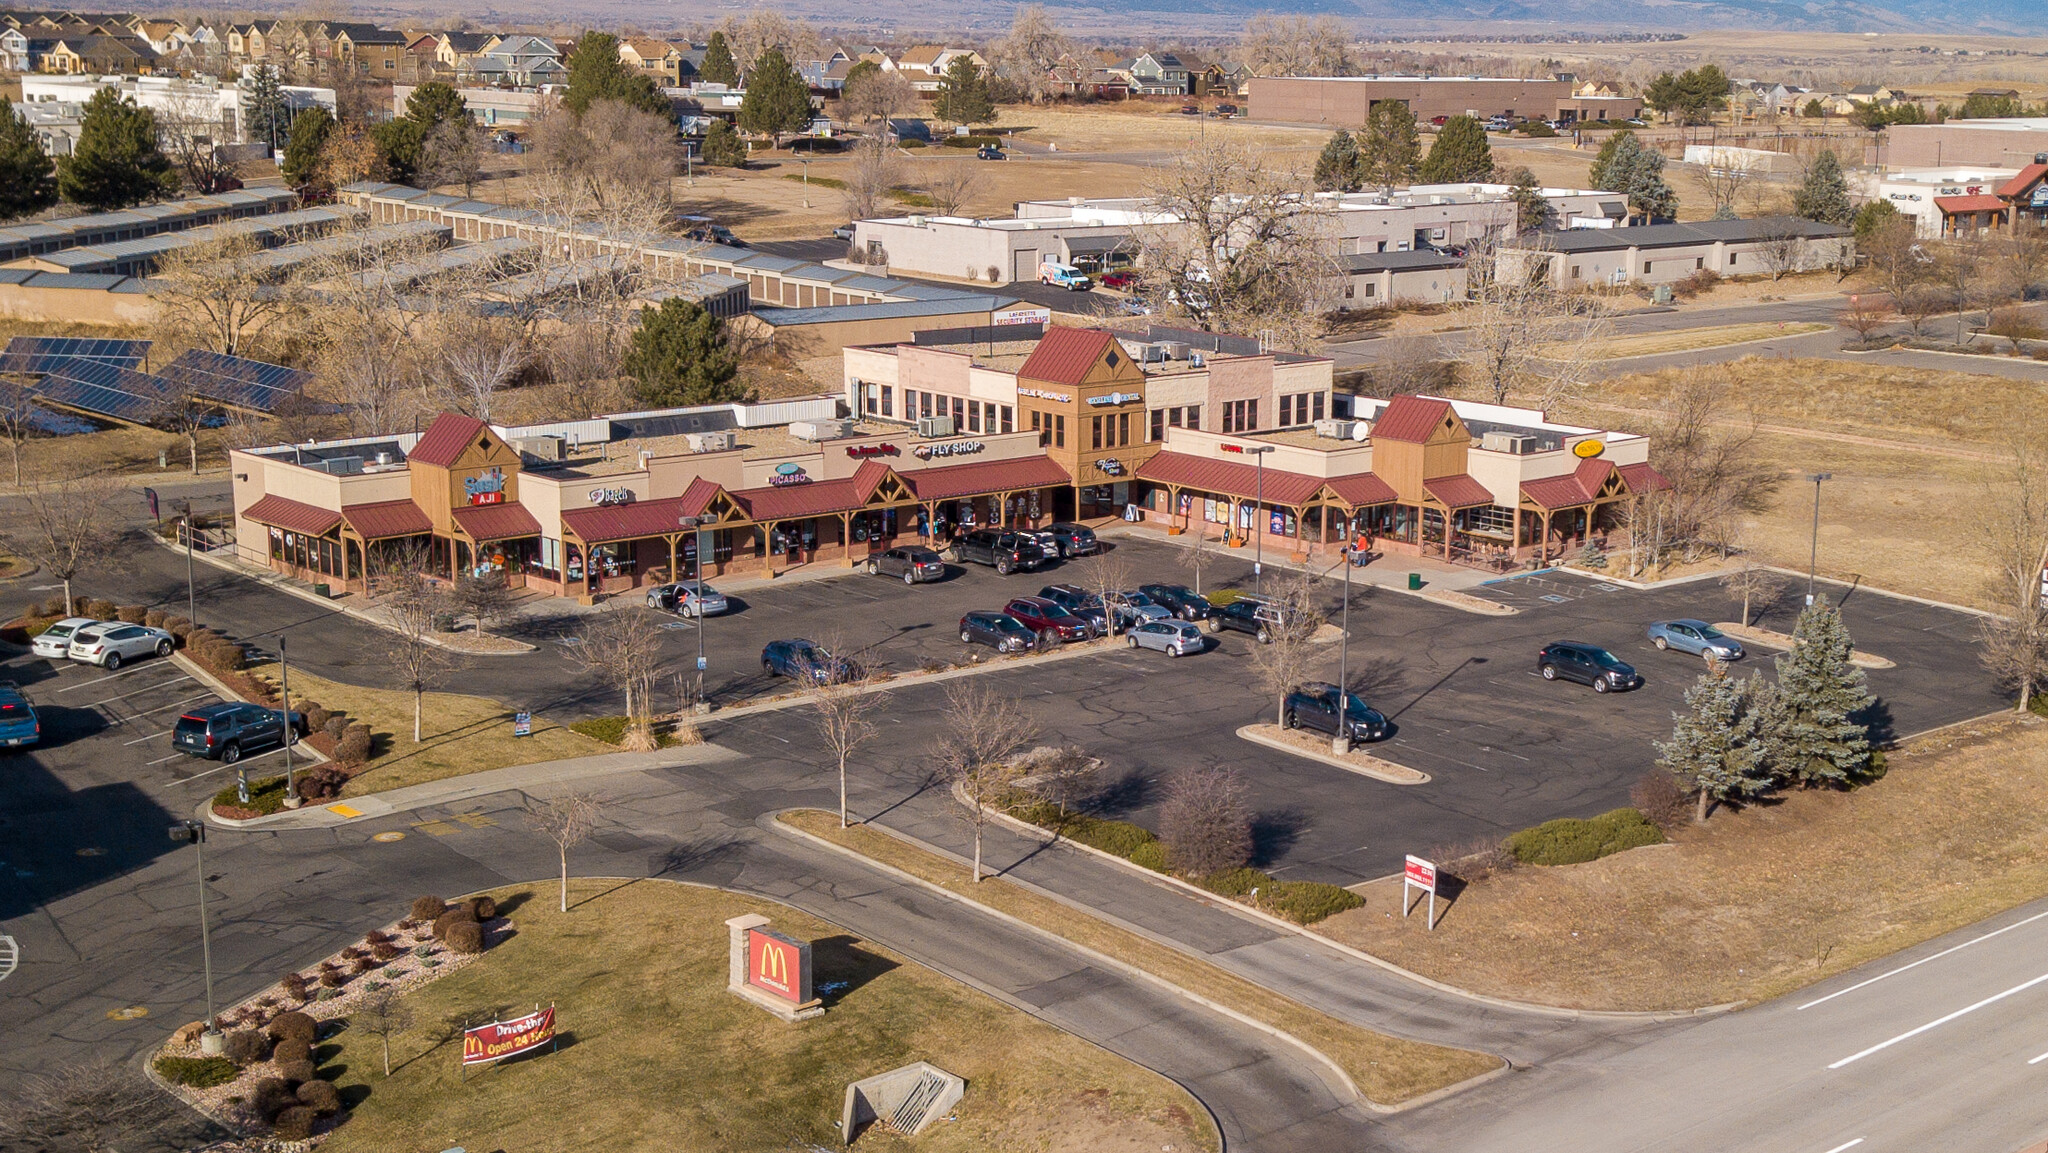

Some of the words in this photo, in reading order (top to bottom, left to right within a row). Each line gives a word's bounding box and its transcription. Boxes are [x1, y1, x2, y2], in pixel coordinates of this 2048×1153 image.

[932, 445, 950, 455] FLY
[952, 441, 981, 452] SHOP
[769, 474, 805, 484] PICASSO
[479, 493, 496, 504] AJI
[605, 486, 628, 504] Bagels
[487, 1041, 513, 1056] Open
[515, 1035, 529, 1048] 24
